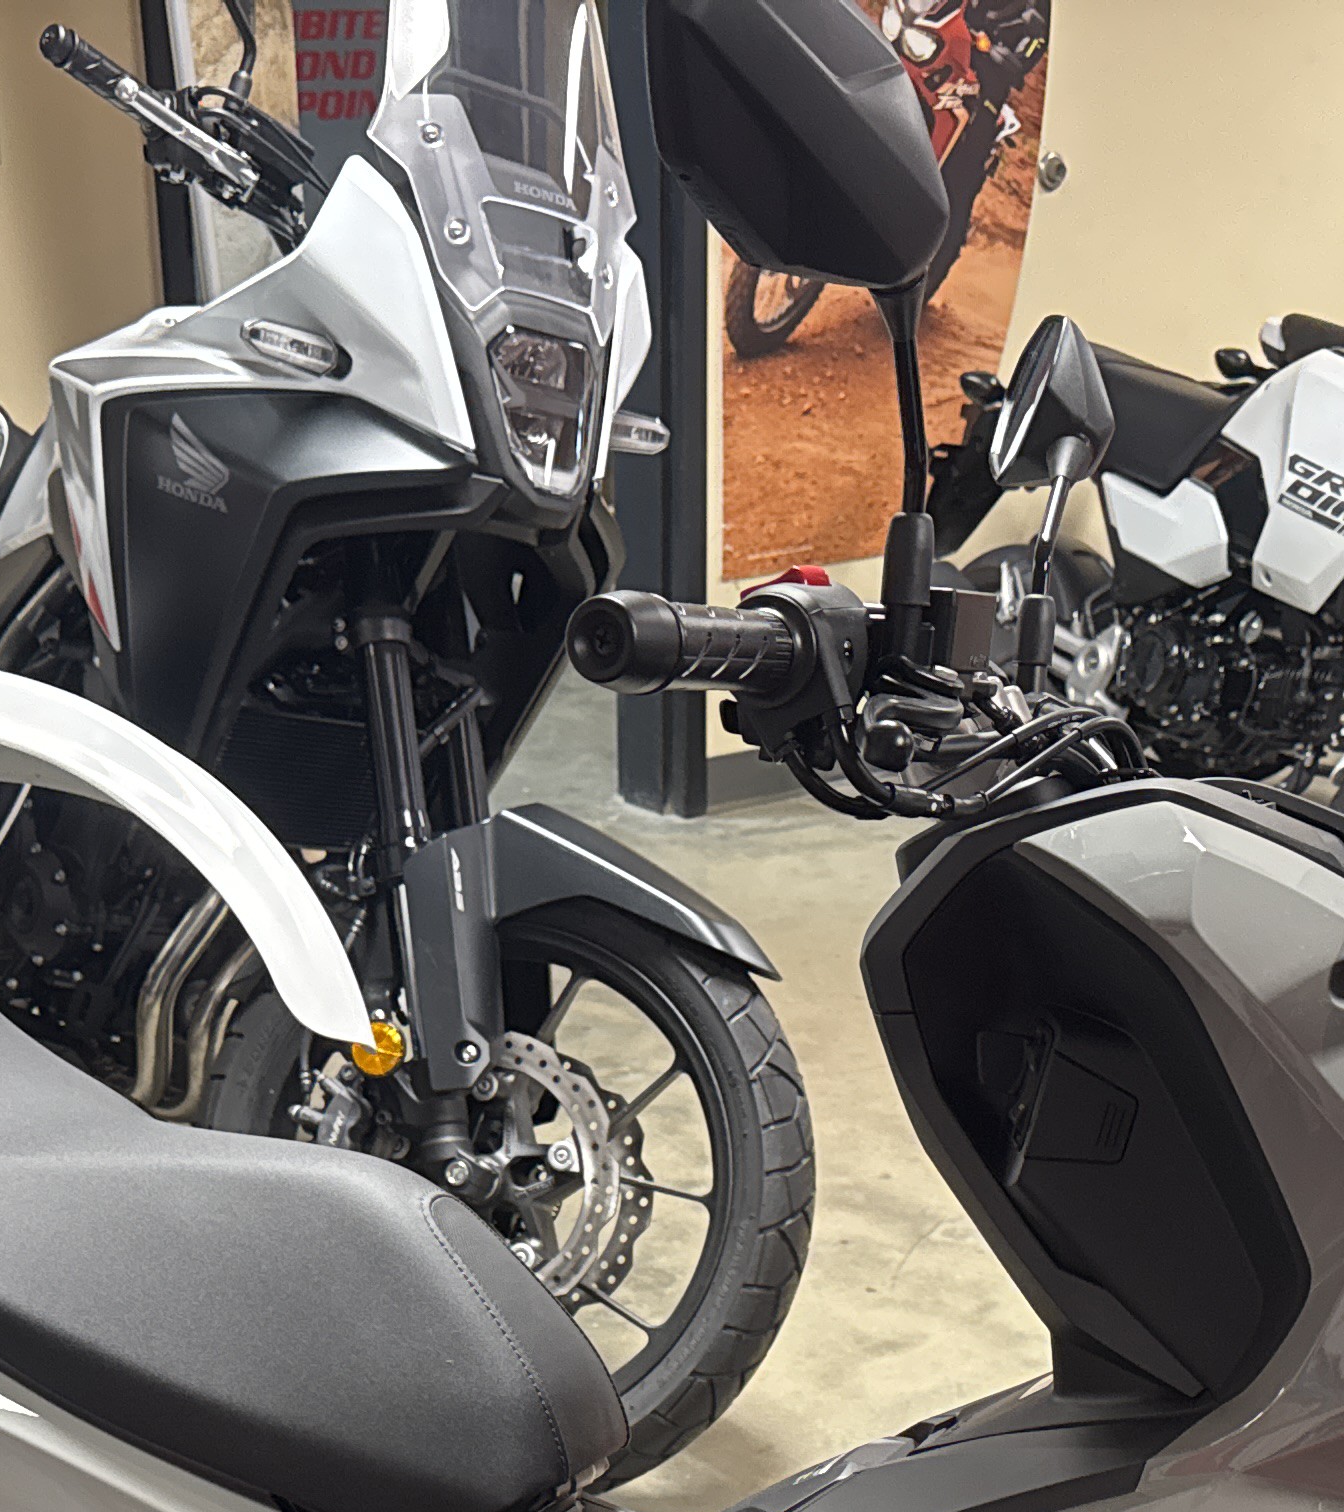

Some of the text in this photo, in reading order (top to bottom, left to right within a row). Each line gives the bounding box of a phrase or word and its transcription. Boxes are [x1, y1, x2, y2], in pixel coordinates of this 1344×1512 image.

[293, 8, 386, 41] BITE
[514, 180, 578, 212] HONDA
[157, 474, 229, 514] HONDA
